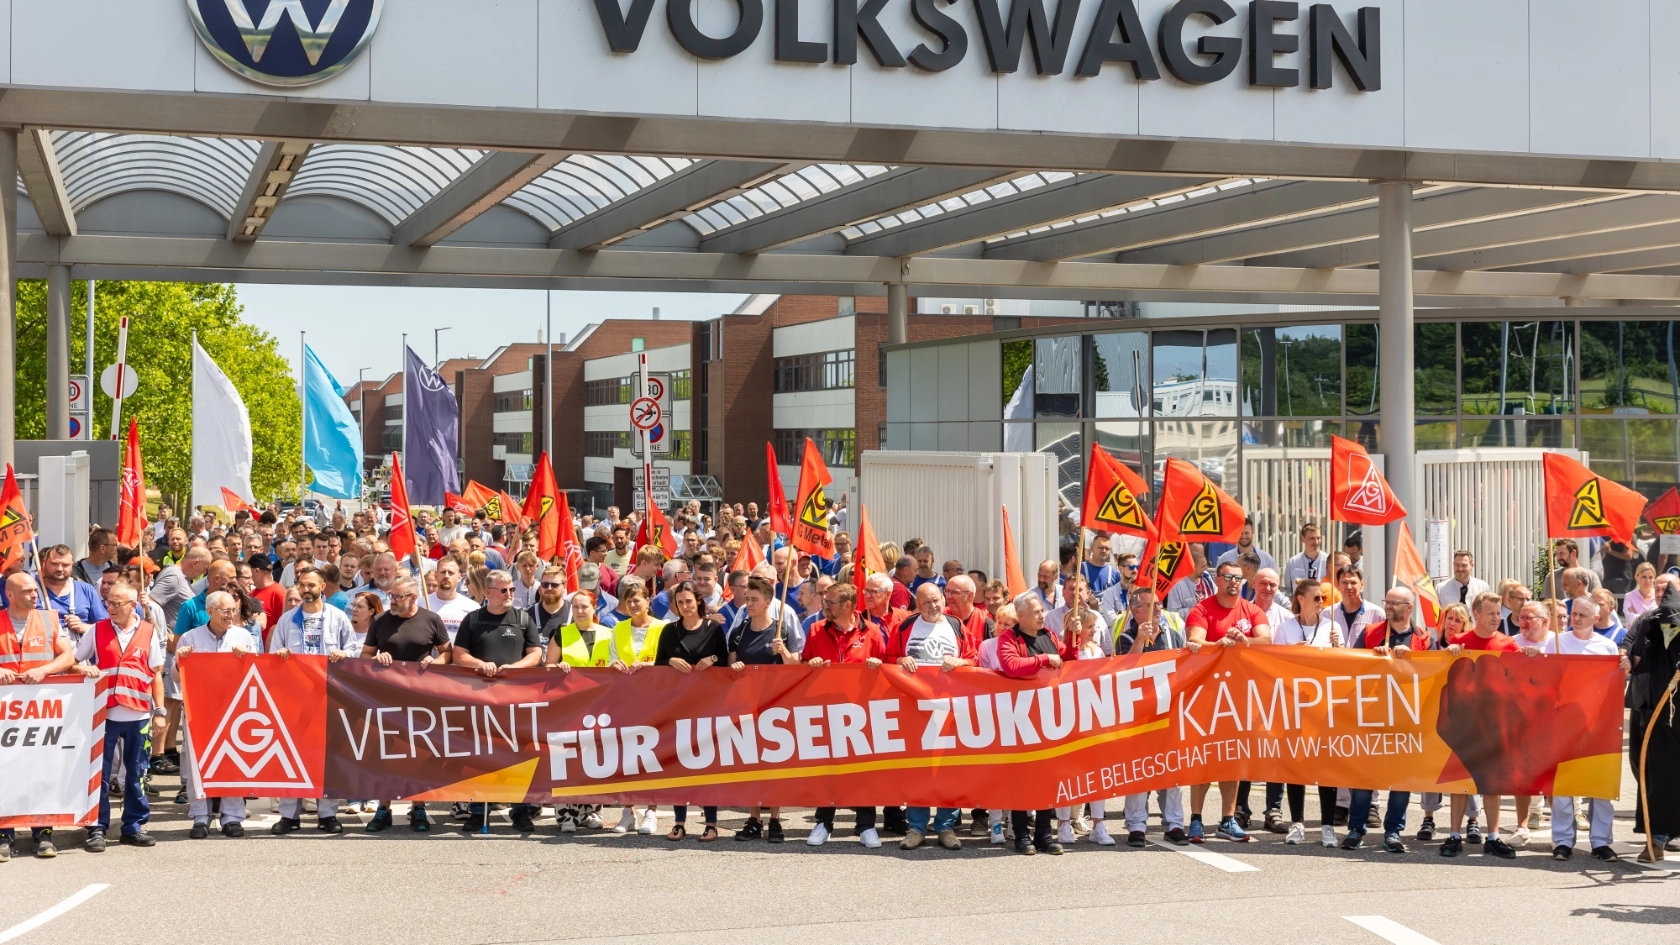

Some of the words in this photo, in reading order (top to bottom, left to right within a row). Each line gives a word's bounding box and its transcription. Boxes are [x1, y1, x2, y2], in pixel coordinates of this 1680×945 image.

[592, 0, 1381, 91] VOLKSWAGEN
[203, 686, 298, 778] IGM
[338, 701, 549, 760] VEREINT
[546, 713, 664, 781] FÜR
[675, 698, 906, 770] UNSERE
[917, 659, 1176, 750] ZUKUNFT
[1178, 671, 1421, 741] KÄMPFEN
[1056, 771, 1097, 803] ALLE
[1100, 738, 1250, 790] BELEGSCHAFTEN
[1257, 738, 1281, 758] IM
[1286, 732, 1423, 759] VW-KONZERN
